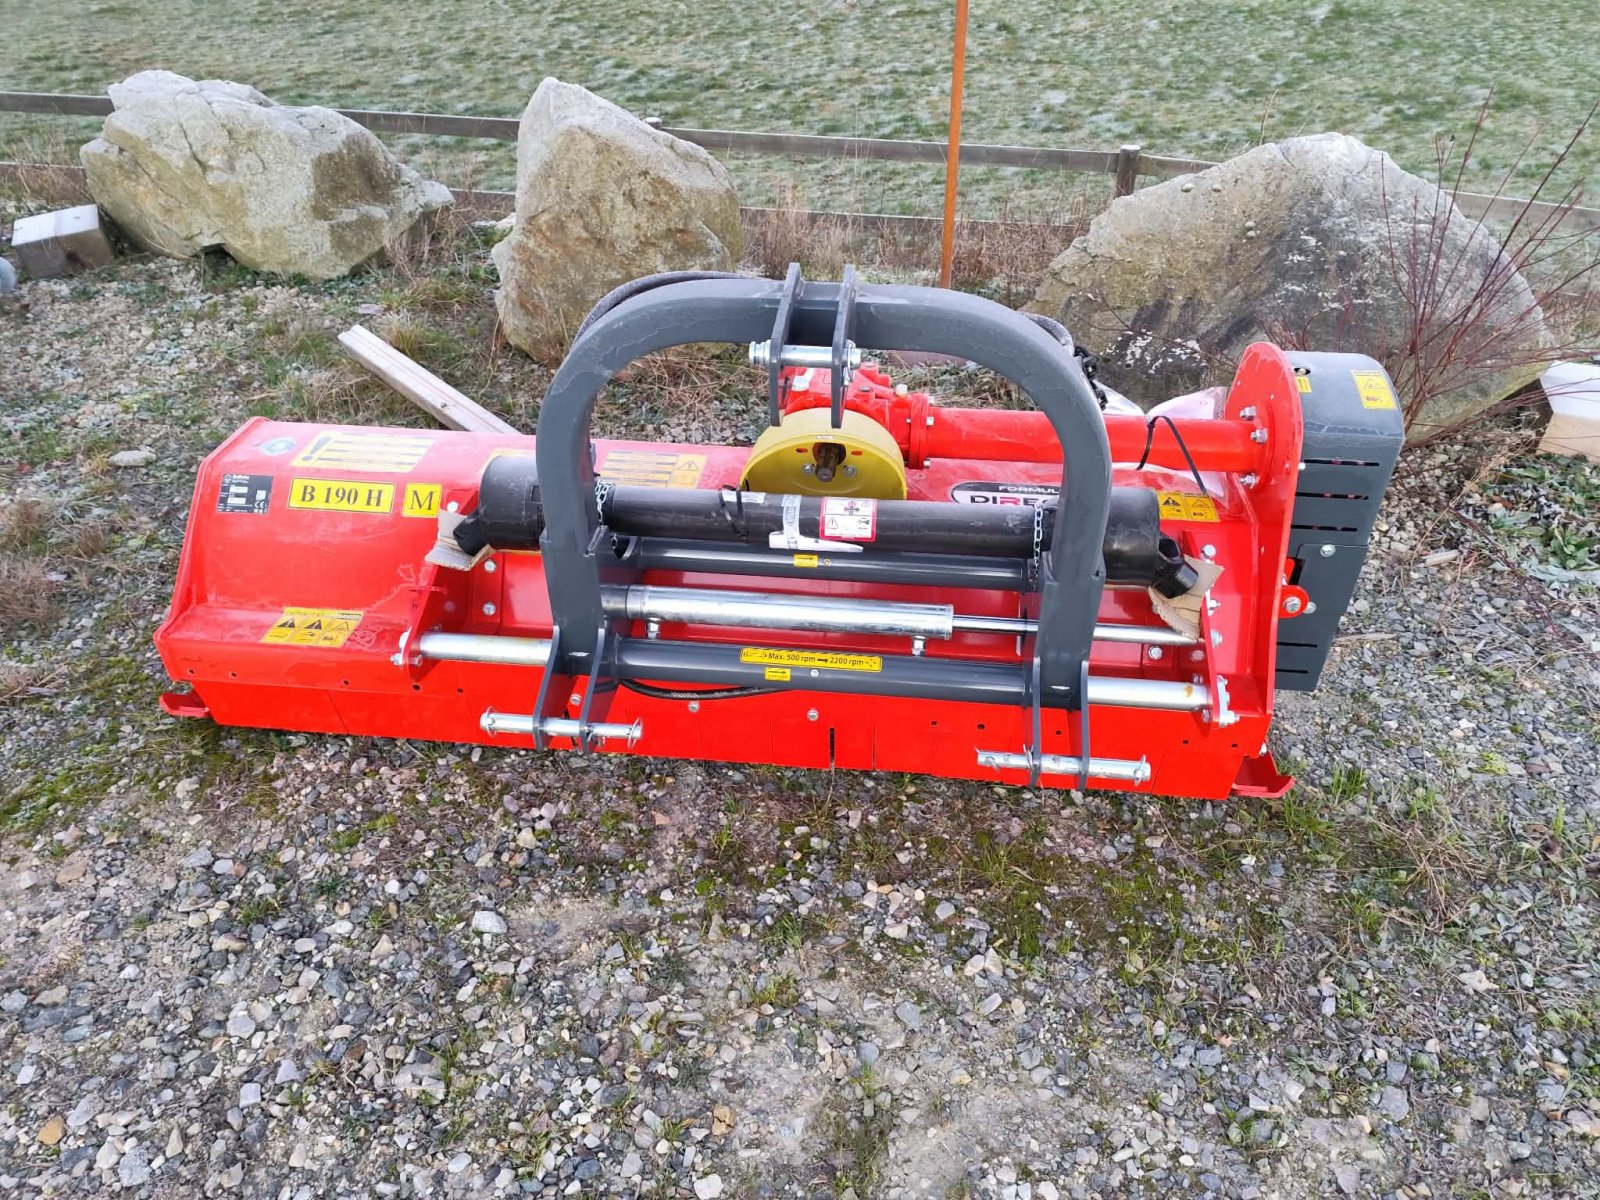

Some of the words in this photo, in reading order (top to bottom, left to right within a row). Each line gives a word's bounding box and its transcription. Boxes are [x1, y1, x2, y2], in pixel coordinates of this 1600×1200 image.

[301, 485, 316, 502] B
[324, 487, 359, 505] 190
[365, 489, 383, 507] H
[410, 490, 435, 511] M
[768, 652, 785, 660] Max.
[786, 652, 800, 661] 500
[800, 655, 816, 663] rpm
[829, 656, 848, 665] 2200
[848, 658, 864, 667] rpm
